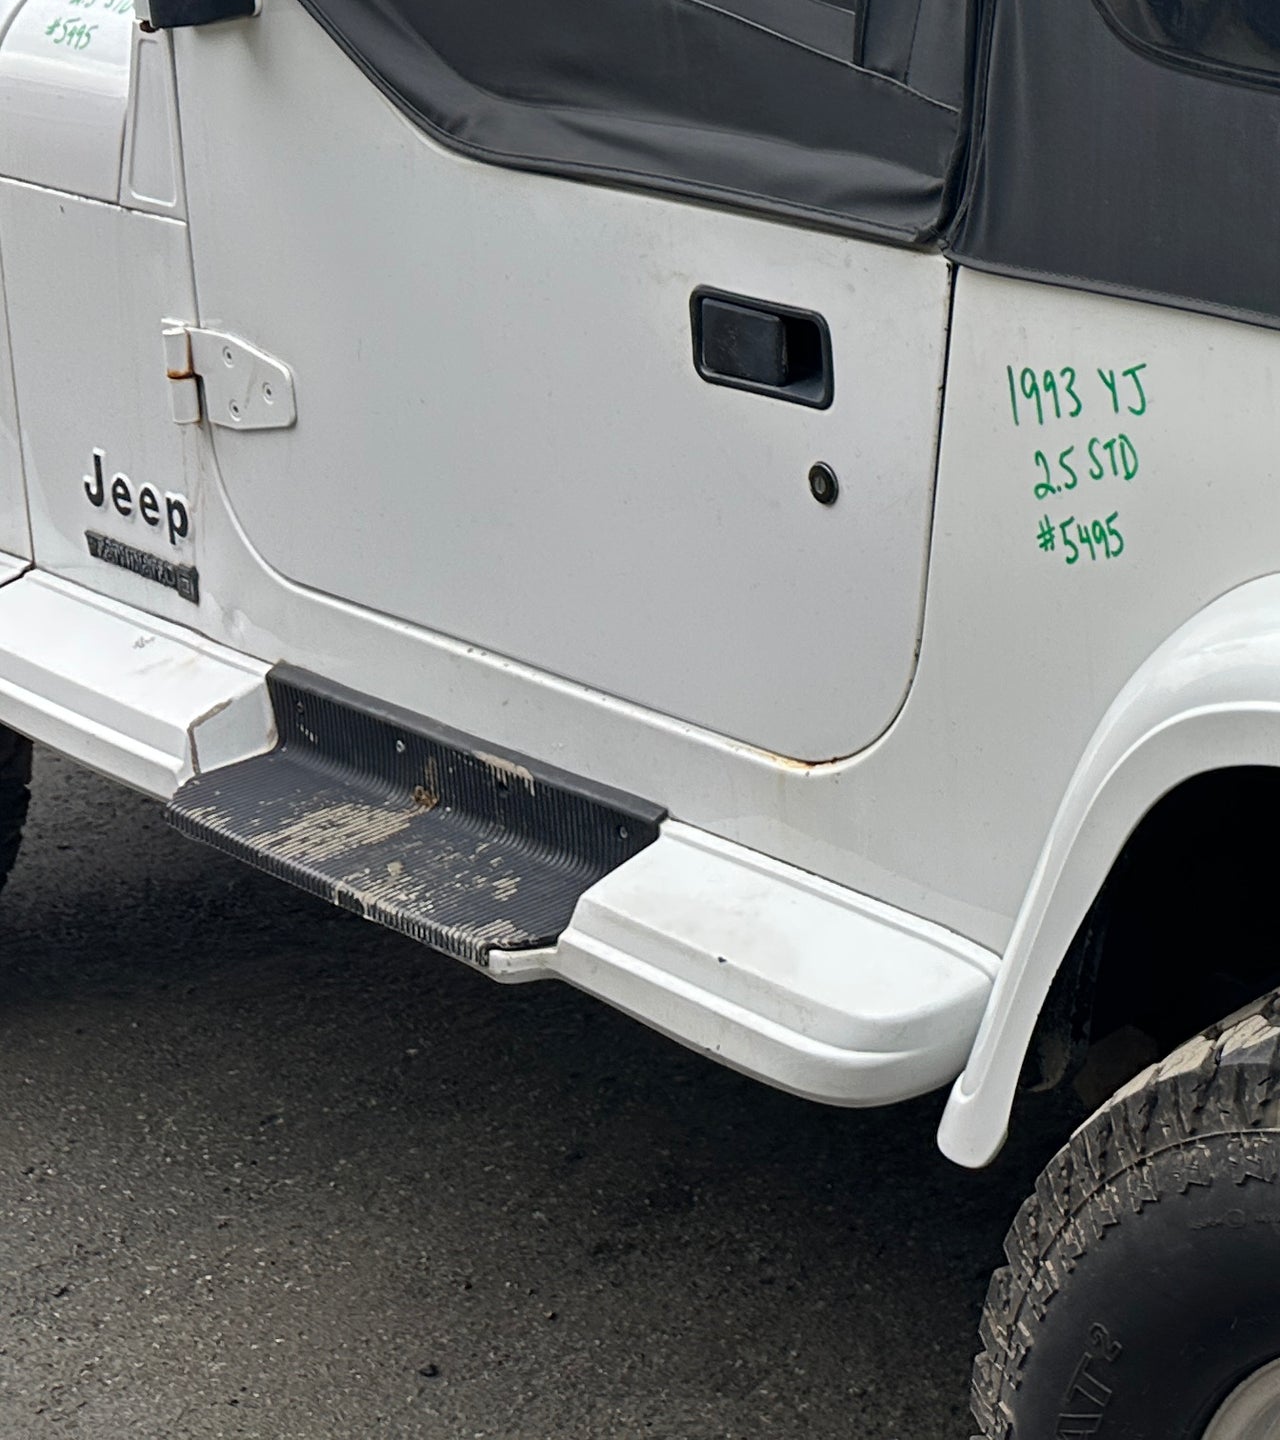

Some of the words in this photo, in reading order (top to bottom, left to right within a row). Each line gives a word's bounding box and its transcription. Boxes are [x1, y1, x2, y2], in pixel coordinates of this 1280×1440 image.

[1006, 365, 1082, 427] 1993
[1096, 362, 1147, 416] YJ
[82, 446, 189, 546] Jeep
[1033, 445, 1078, 500] 2.5
[1087, 433, 1139, 481] STD
[1036, 510, 1124, 564] #5495
